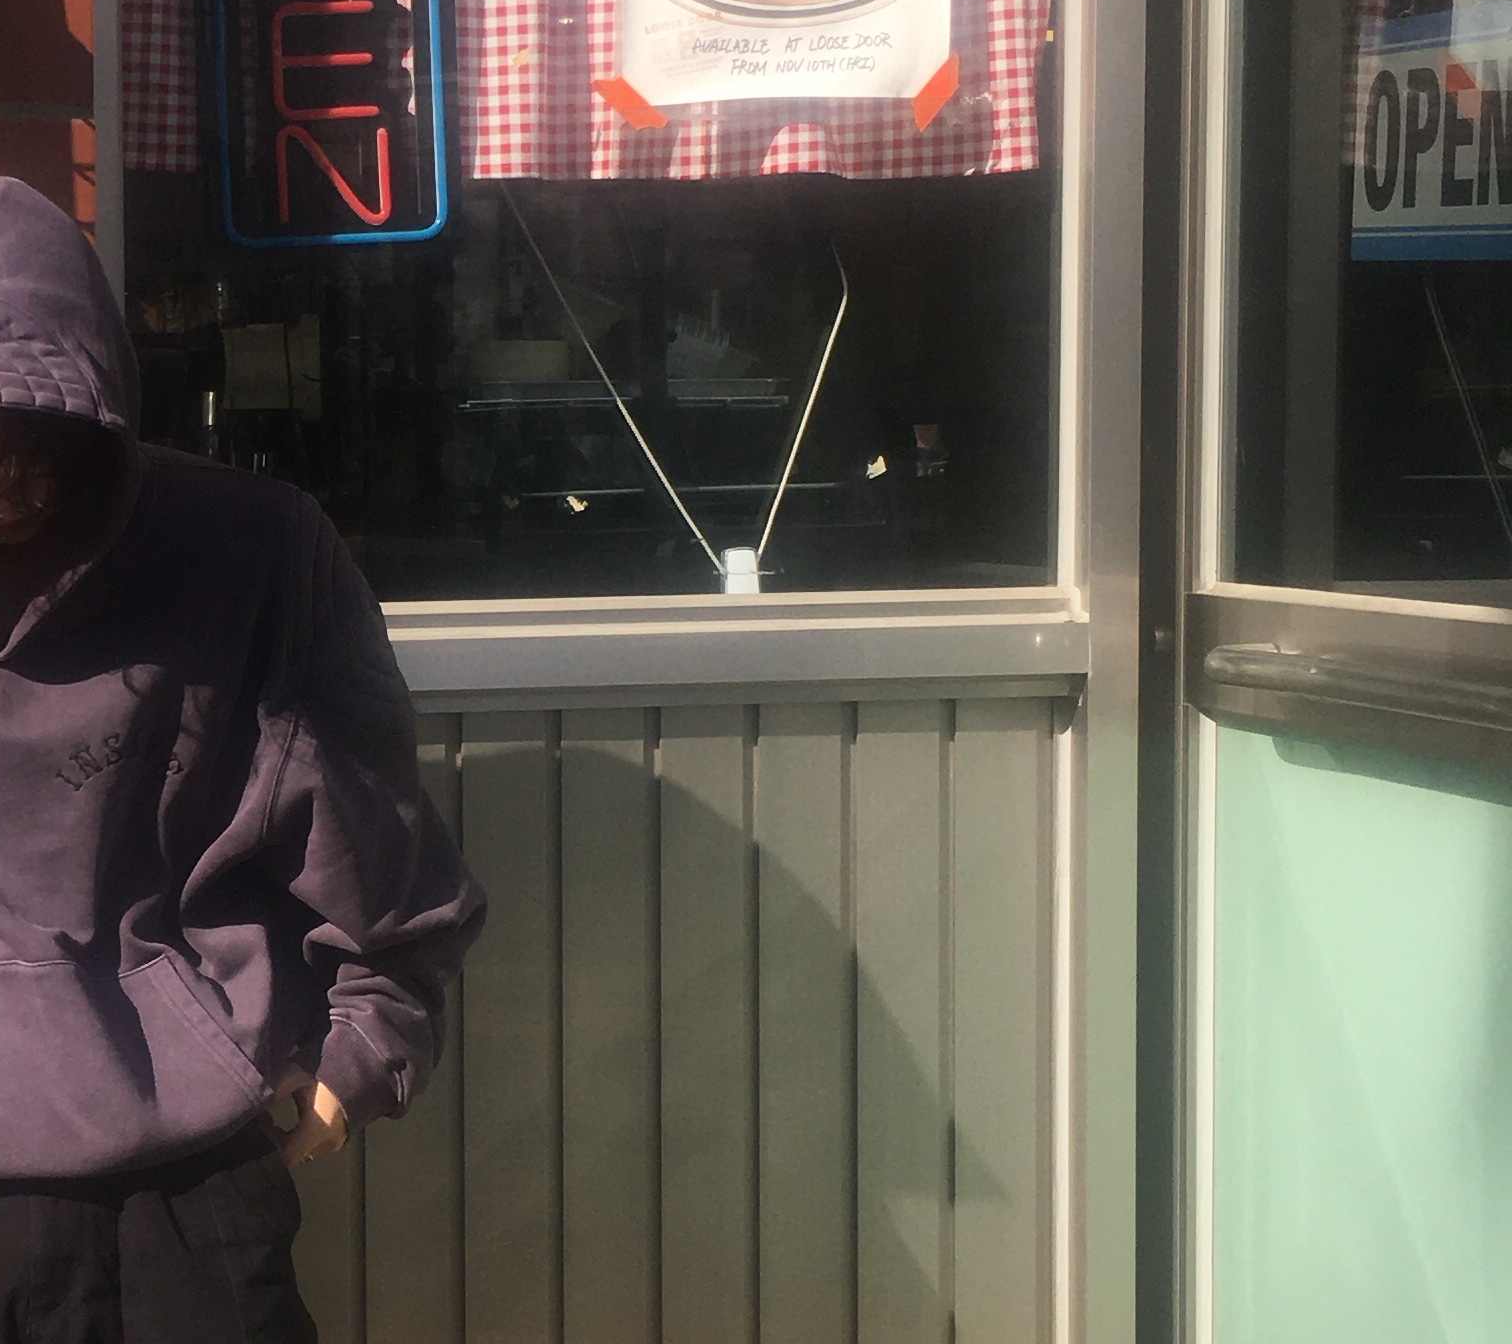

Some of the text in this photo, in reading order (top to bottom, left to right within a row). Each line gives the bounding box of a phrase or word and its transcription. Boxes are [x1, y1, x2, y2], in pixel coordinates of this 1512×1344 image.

[692, 36, 771, 55] AVAILABLE
[784, 36, 804, 53] AT
[809, 34, 850, 52] LOOSE
[852, 31, 893, 50] DOOR
[730, 57, 768, 76] FROM
[775, 58, 805, 74] NOV
[1364, 59, 1512, 212] OPEN
